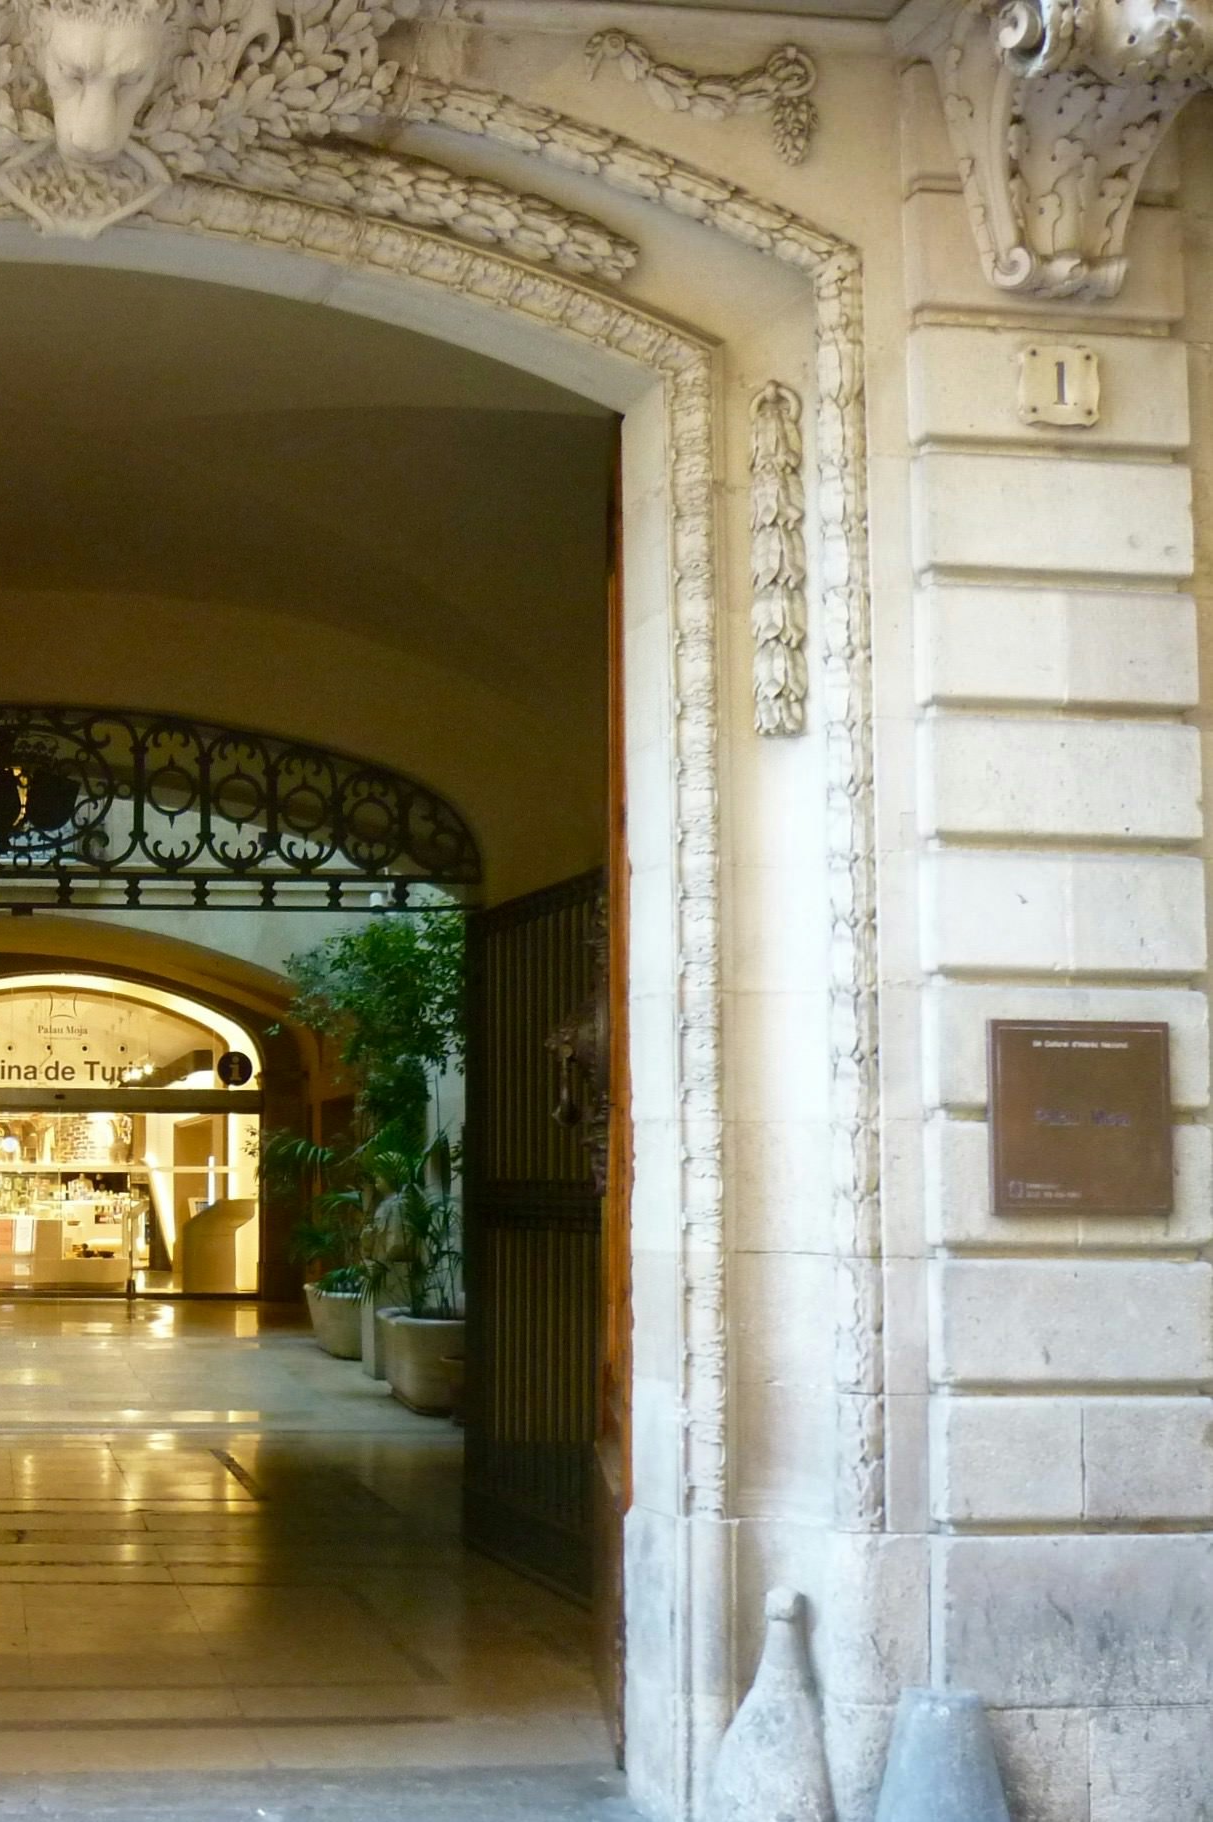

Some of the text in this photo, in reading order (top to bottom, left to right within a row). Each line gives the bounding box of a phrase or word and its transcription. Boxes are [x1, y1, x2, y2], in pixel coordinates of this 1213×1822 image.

[37, 1024, 88, 1036] Palau Moja
[44, 1060, 75, 1081] de
